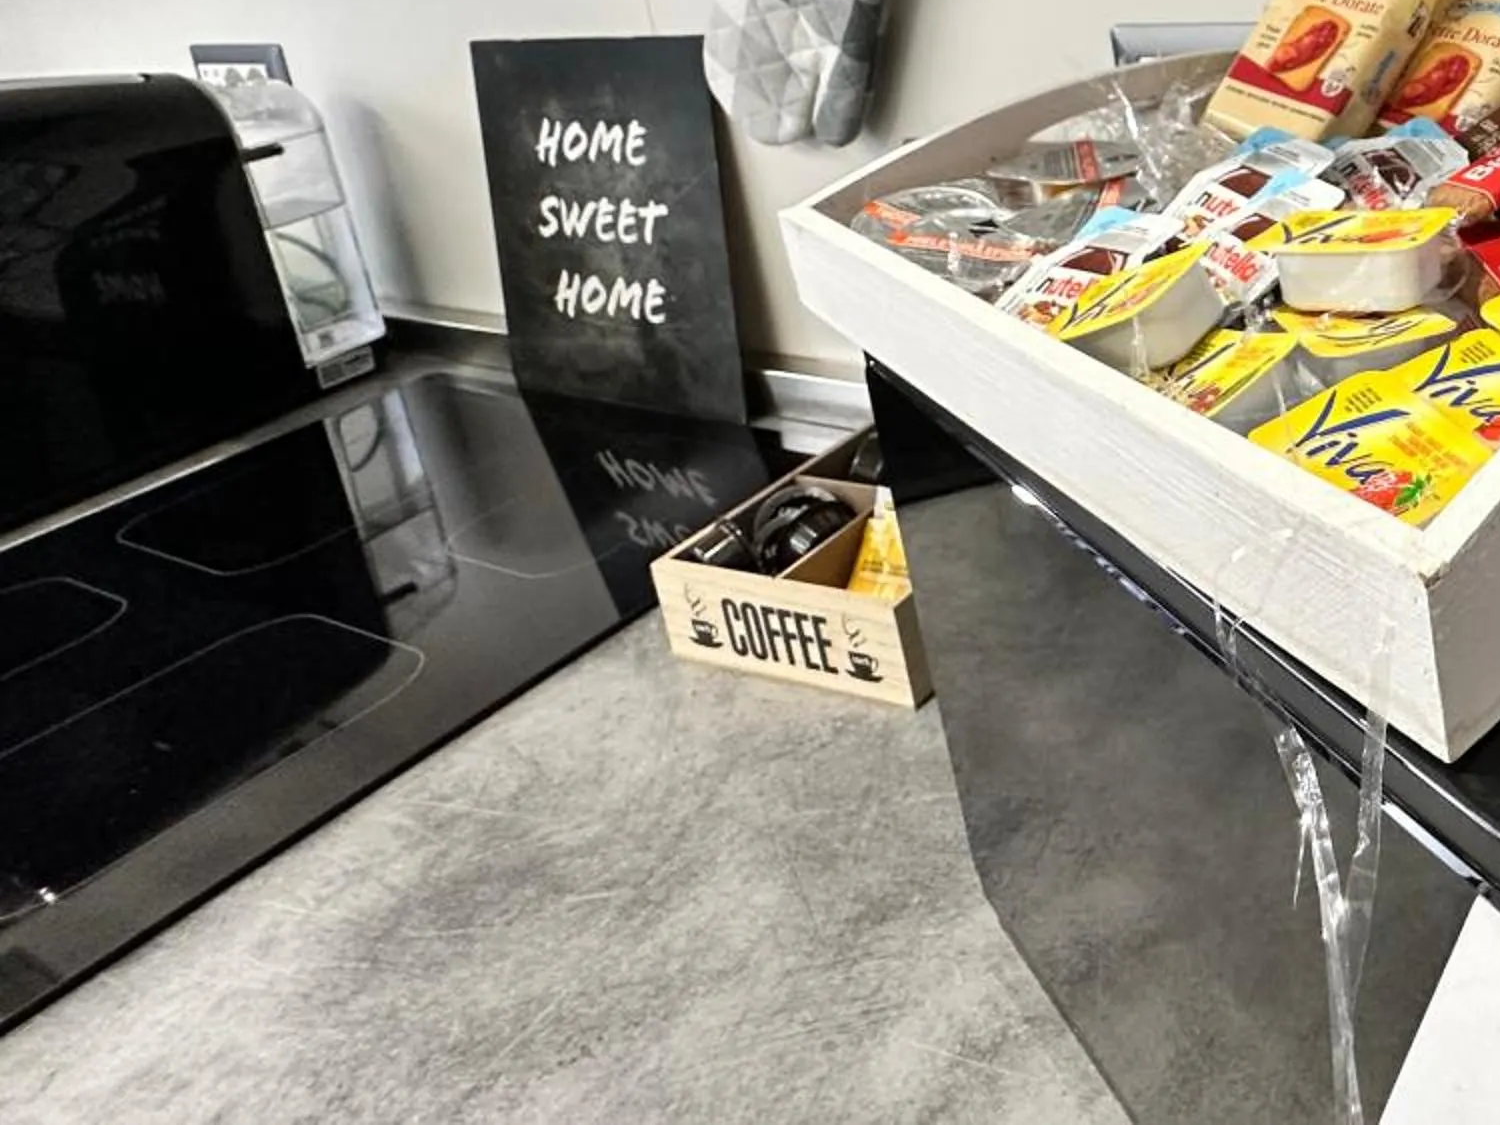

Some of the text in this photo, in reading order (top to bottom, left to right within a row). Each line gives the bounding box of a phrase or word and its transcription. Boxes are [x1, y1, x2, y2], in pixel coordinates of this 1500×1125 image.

[535, 117, 648, 167] HOME
[537, 195, 669, 245] SWEET
[553, 268, 667, 325] HOME
[1295, 389, 1412, 486] Viva
[720, 597, 841, 675] COFFEE
